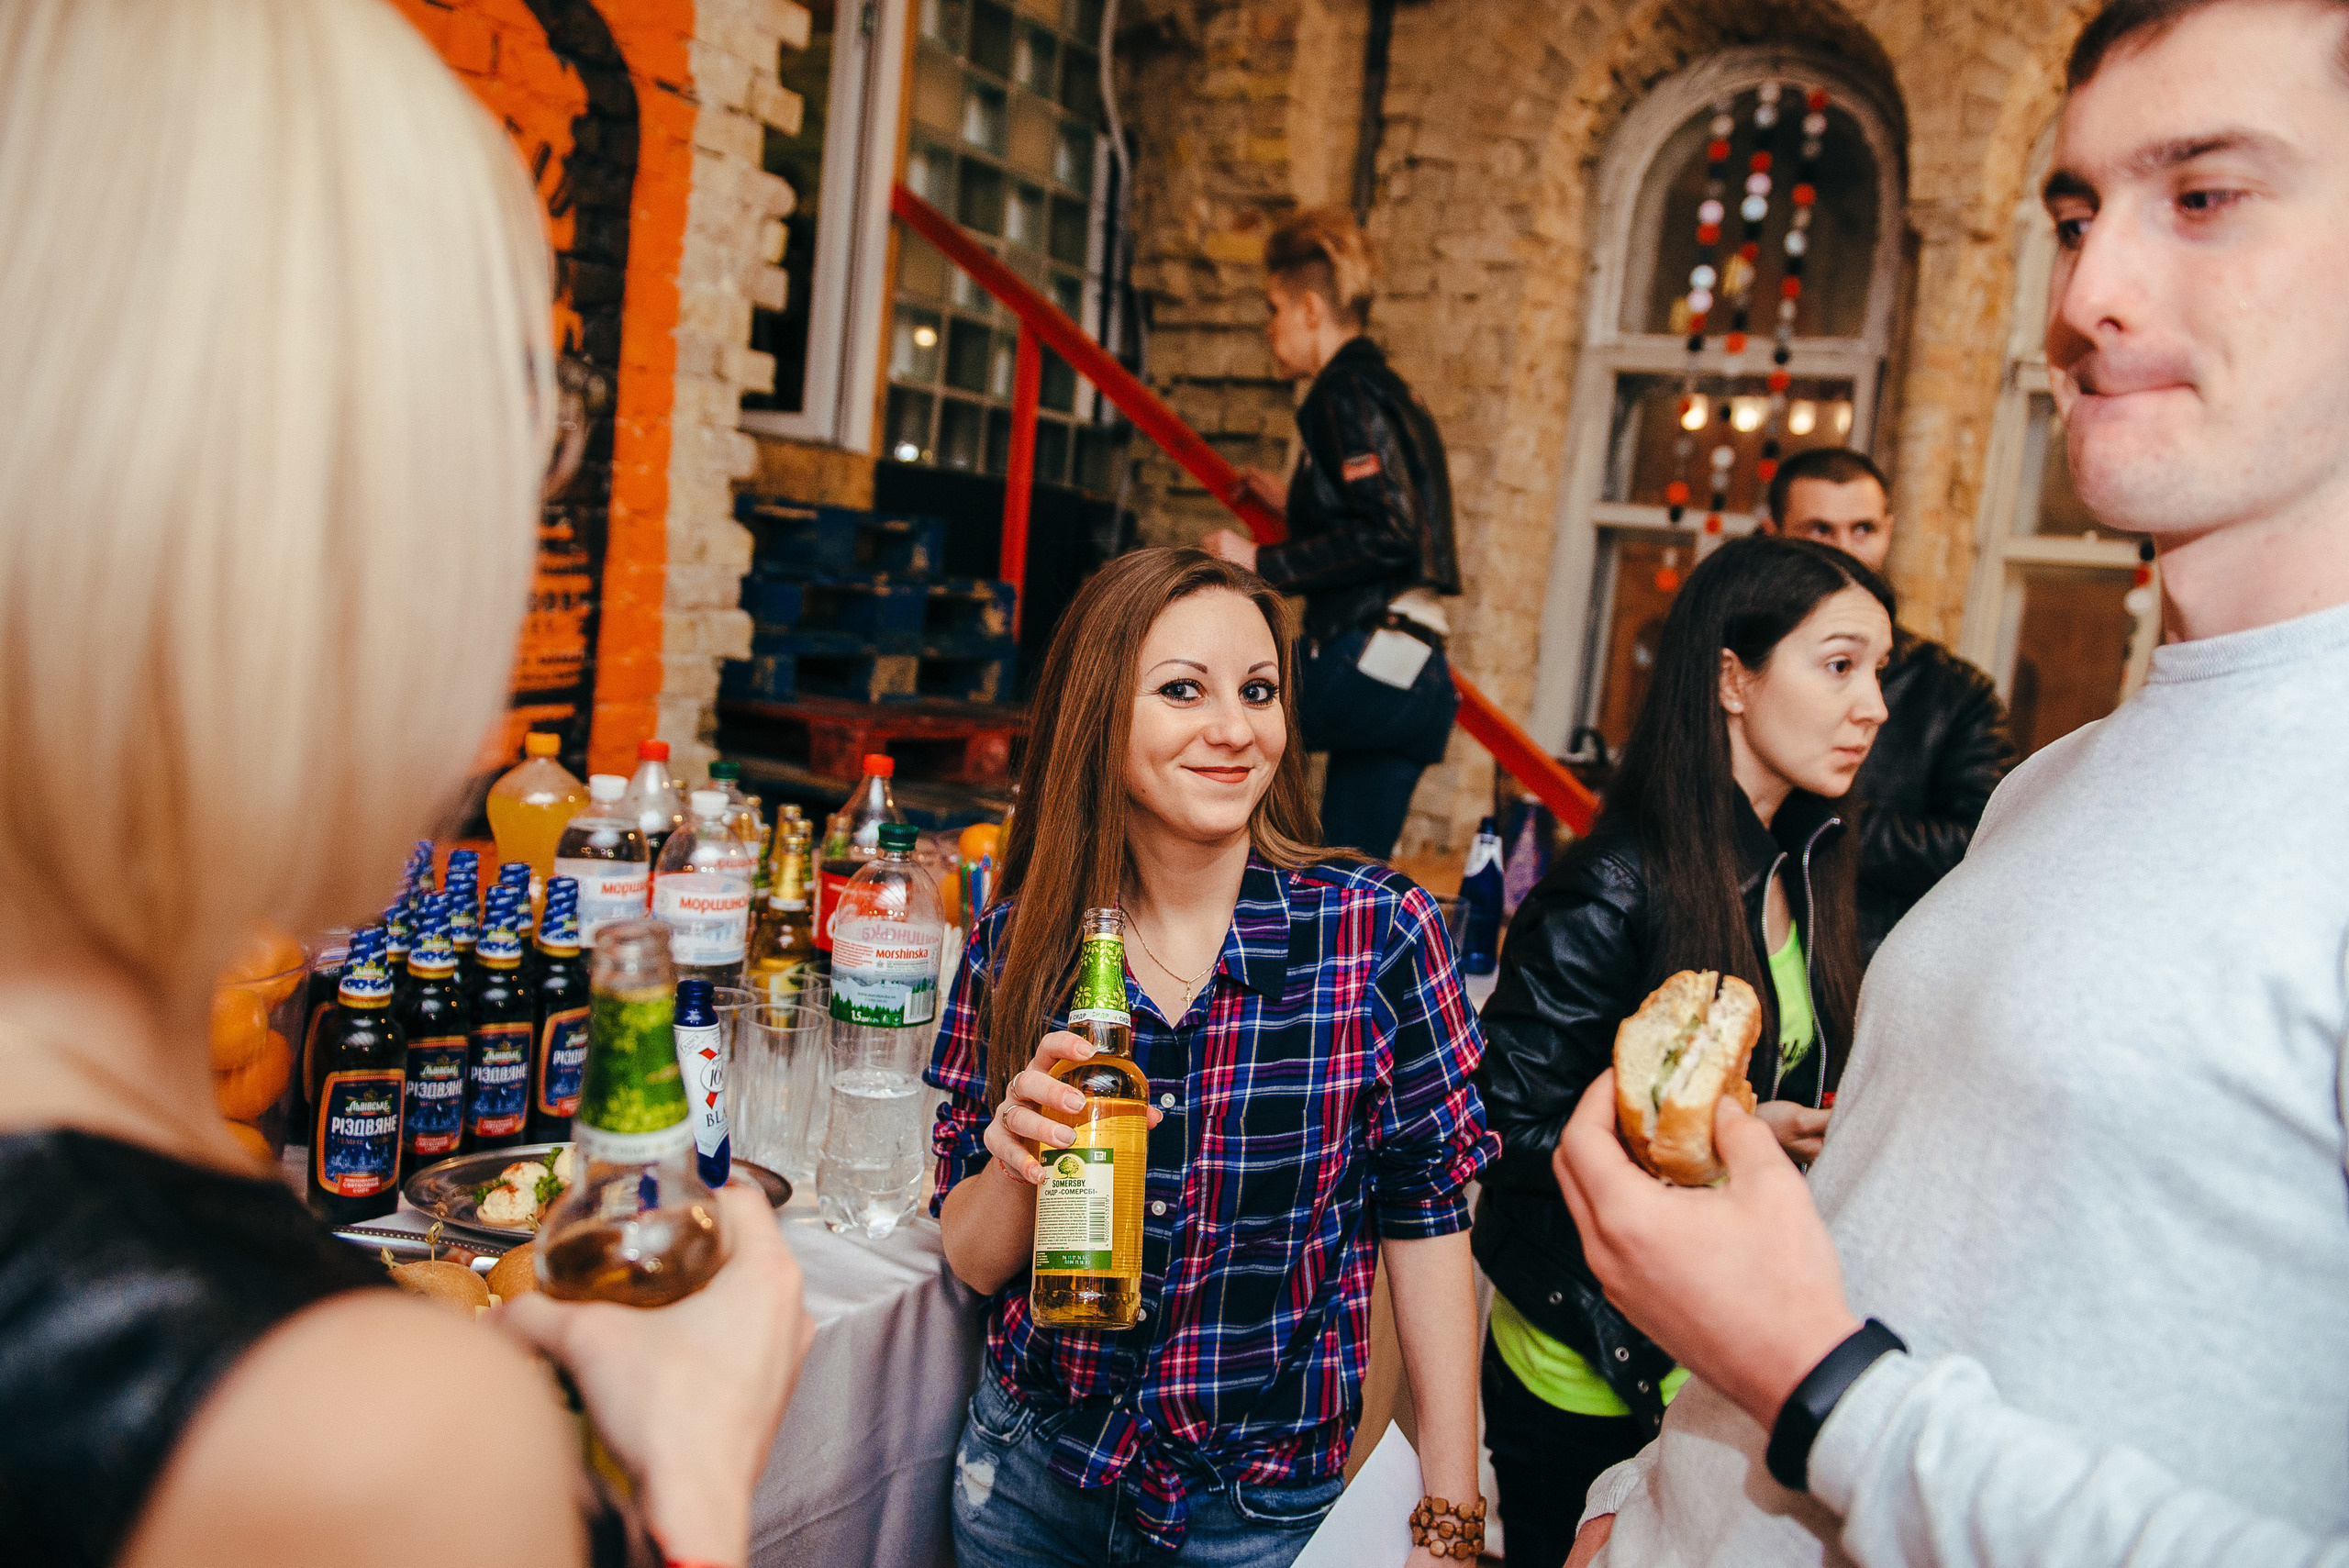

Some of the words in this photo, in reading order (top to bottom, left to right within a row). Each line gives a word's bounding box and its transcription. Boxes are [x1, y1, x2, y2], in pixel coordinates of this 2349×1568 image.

[875, 947, 929, 960] Morshinska
[330, 1113, 398, 1138] РІЗДВЯНЕ
[1052, 1179, 1086, 1188] SOMERSBY
